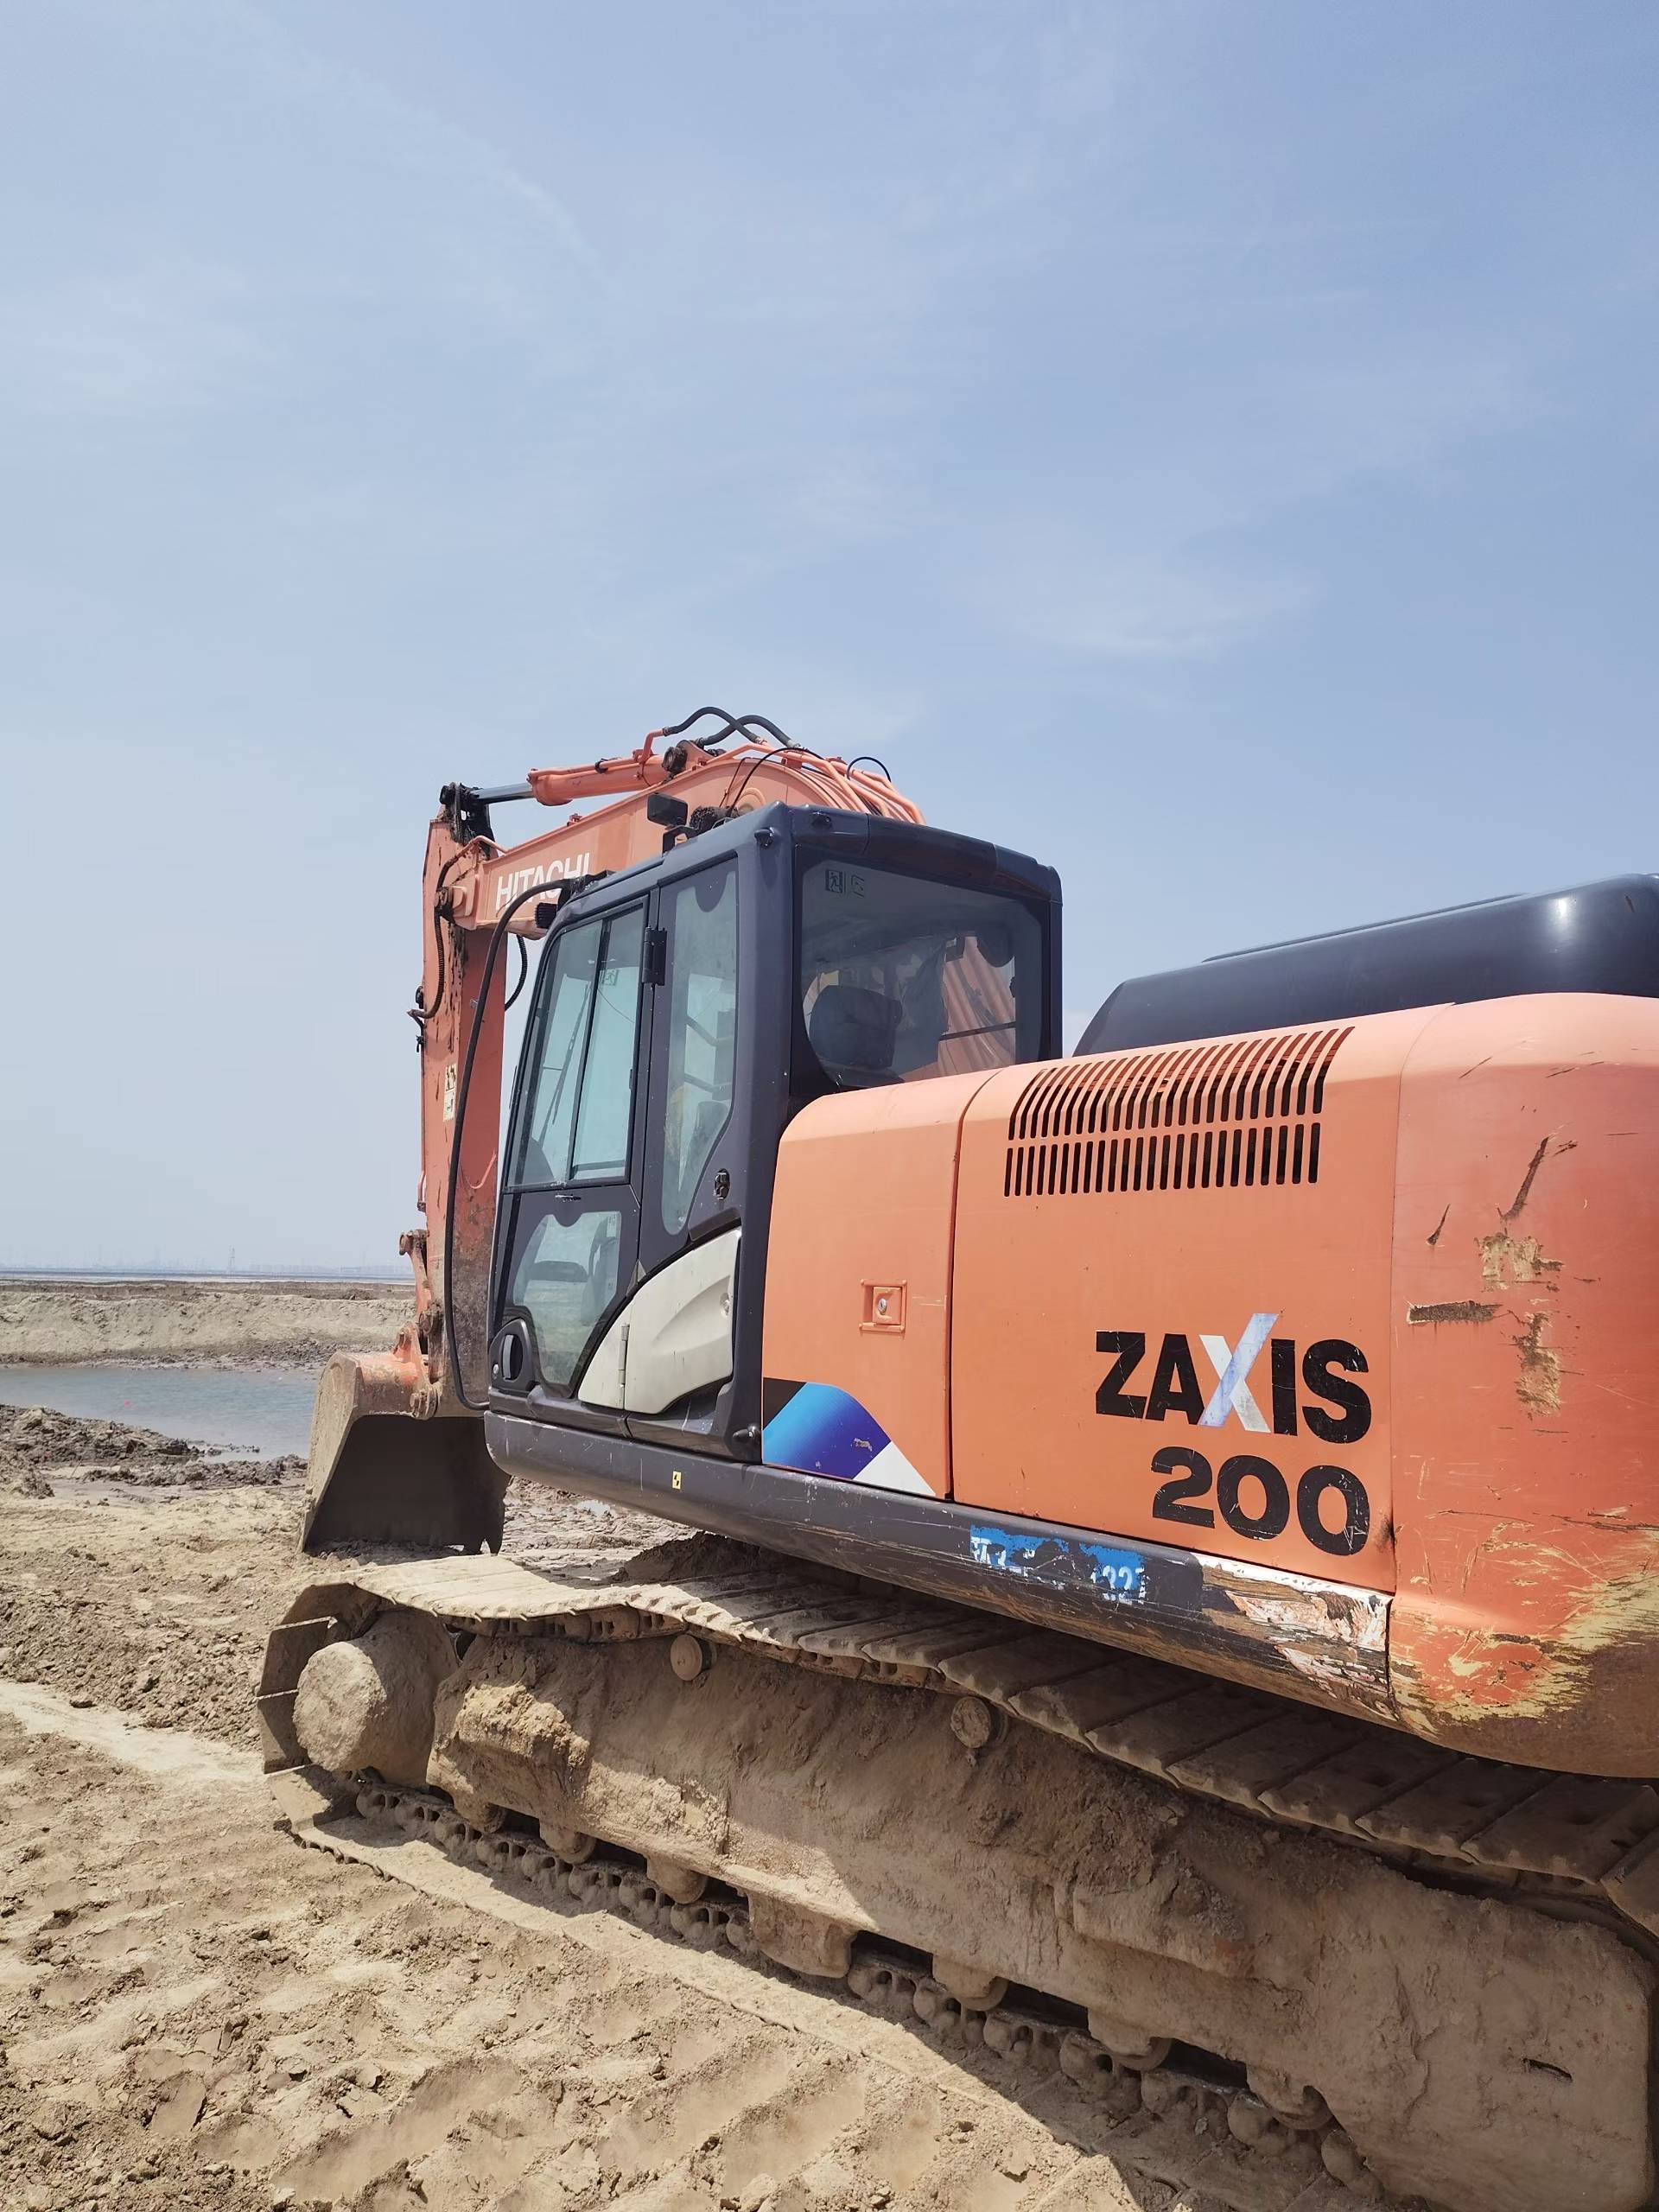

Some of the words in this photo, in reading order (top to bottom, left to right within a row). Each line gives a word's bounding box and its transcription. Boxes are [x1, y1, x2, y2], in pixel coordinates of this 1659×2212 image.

[495, 852, 591, 911] HITACHI
[1096, 1313, 1372, 1445] ZAXIS
[1150, 1446, 1370, 1557] 200
